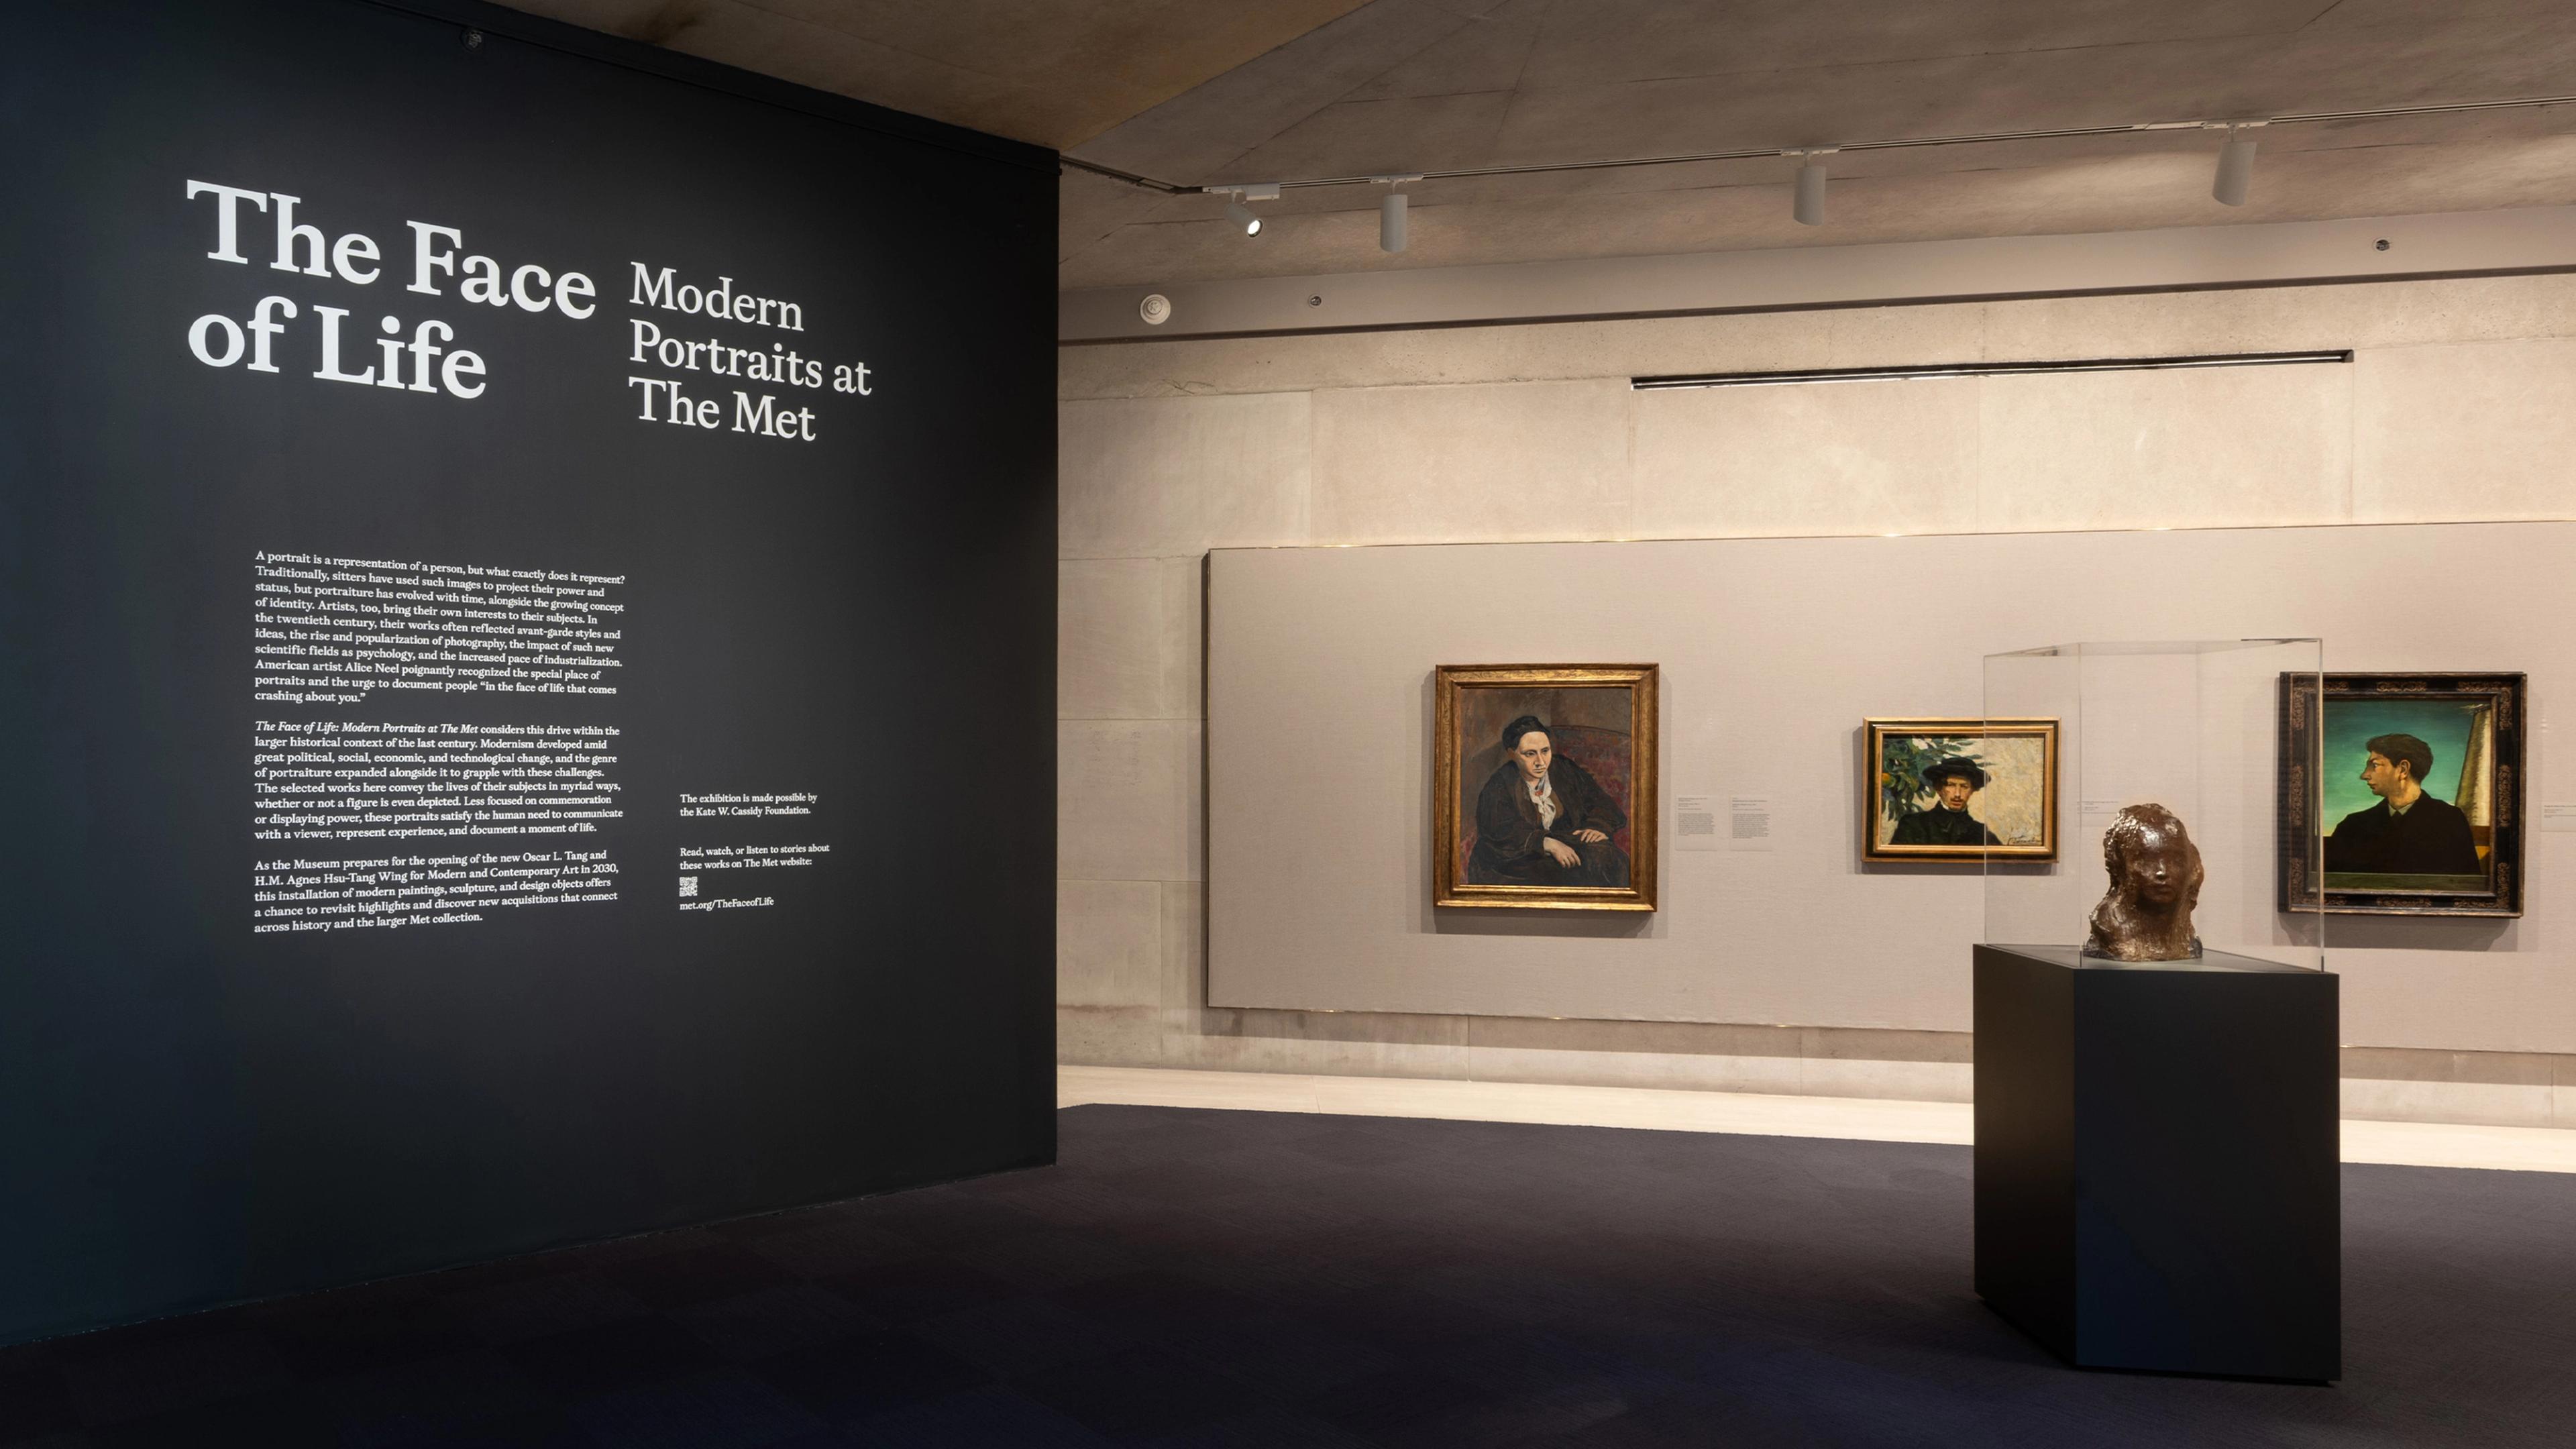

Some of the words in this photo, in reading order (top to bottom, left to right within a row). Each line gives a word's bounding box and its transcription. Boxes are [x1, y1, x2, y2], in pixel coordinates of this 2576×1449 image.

[187, 180, 380, 284] The
[407, 221, 595, 319] Face
[630, 262, 804, 331] Modern
[189, 296, 297, 373] of
[313, 305, 486, 398] Life
[630, 319, 822, 388] Portraits
[834, 362, 871, 395] at
[629, 376, 719, 429] The
[732, 391, 816, 441] Met
[256, 551, 265, 560] A
[268, 553, 311, 564] portrait
[313, 554, 322, 564] is
[333, 558, 407, 570] representation
[410, 561, 421, 570] of
[430, 565, 466, 575] person,
[468, 565, 484, 575] but
[486, 567, 510, 577] what
[512, 570, 546, 582] exactly
[548, 570, 569, 581] does
[571, 572, 578, 581] it
[580, 575, 625, 585] represent?
[255, 583, 291, 594] status,
[294, 583, 312, 594] but
[314, 587, 374, 598] portraiture
[376, 588, 394, 598] has
[396, 590, 434, 601] evolved
[435, 592, 460, 602] with
[461, 594, 486, 605] time,
[488, 595, 532, 608] alongside
[533, 598, 549, 608] the
[550, 600, 588, 612] growing
[590, 604, 624, 614] concept
[255, 612, 274, 623] the
[277, 614, 331, 625] twentieth
[333, 619, 377, 631] century,
[380, 619, 405, 629] their
[408, 621, 439, 631] works
[441, 621, 468, 632] often
[471, 623, 515, 634] reflected
[517, 627, 574, 639] avant-garde
[575, 629, 602, 640] styles
[603, 630, 621, 639] and
[255, 676, 305, 687] portraits
[308, 676, 329, 686] and
[331, 676, 350, 687] the
[352, 680, 376, 690] urge
[378, 680, 390, 688] to
[392, 678, 443, 690] document
[445, 680, 478, 693] people
[498, 682, 514, 691] the
[516, 682, 536, 692] face
[537, 683, 549, 692] of
[549, 683, 565, 692] life
[567, 684, 586, 693] that
[256, 720, 276, 731] The
[278, 721, 302, 731] Face
[303, 721, 316, 735] of
[316, 722, 339, 735] Life:
[341, 722, 380, 732] Modern
[382, 722, 426, 733] Portraits
[427, 725, 438, 733] at
[440, 723, 459, 733] The
[460, 724, 478, 733] Met
[480, 724, 525, 734] considers
[527, 724, 545, 735] this
[547, 725, 571, 735] drive
[573, 726, 603, 735] within
[605, 726, 620, 735] the
[254, 753, 284, 765] great
[287, 752, 335, 765] political,
[338, 752, 371, 763] social,
[374, 753, 426, 764] economic,
[429, 753, 447, 762] and
[450, 753, 515, 765] technological
[517, 753, 553, 765] change,
[555, 753, 573, 763] and
[575, 753, 590, 763] the
[592, 755, 617, 765] genre
[680, 794, 698, 803] The
[699, 794, 741, 803] exhibition
[743, 794, 750, 802] is
[751, 793, 773, 802] made
[775, 793, 806, 804] possible
[808, 792, 818, 804] by
[680, 807, 694, 816] the
[696, 807, 716, 816] Kate
[718, 807, 730, 816] W.
[731, 806, 763, 818] Cassidy
[765, 806, 811, 815] Foundation.
[254, 829, 282, 839] with
[294, 829, 333, 839] viewer,
[336, 828, 386, 841] represent
[388, 826, 447, 839] experience,
[449, 825, 468, 835] and
[470, 825, 518, 835] document
[528, 824, 567, 833] moment
[568, 822, 579, 833] of
[580, 822, 597, 832] life.
[680, 847, 704, 857] Read,
[706, 846, 734, 856] watch,
[746, 845, 768, 854] listen
[780, 845, 806, 853] stories
[808, 843, 830, 852] about
[254, 861, 270, 871] As
[272, 859, 290, 870] the
[293, 859, 340, 869] Museum
[343, 859, 389, 871] prepares
[391, 856, 407, 866] for
[409, 855, 425, 865] the
[428, 855, 468, 867] opening
[470, 853, 481, 863] of
[482, 853, 498, 863] the
[523, 852, 551, 862] Oscar
[553, 851, 562, 861] L.
[564, 851, 588, 863] Tang
[590, 850, 606, 859] and
[680, 861, 702, 870] these
[704, 859, 730, 869] works
[743, 859, 761, 867] The
[762, 858, 778, 867] Met
[780, 857, 812, 866] website:
[255, 875, 284, 886] H.M.
[286, 875, 321, 888] Agnes
[324, 873, 376, 885] Hsu-Tang
[378, 871, 408, 883] Wing
[410, 870, 425, 880] for
[427, 869, 466, 879] Modern
[469, 868, 488, 878] and
[490, 867, 560, 879] Contemporary
[561, 865, 579, 874] Art
[581, 865, 590, 873] in
[592, 863, 619, 873] 2030,
[680, 897, 774, 912] met.org/TheFaceofLife
[254, 924, 290, 932] across
[292, 920, 332, 932] history
[334, 918, 354, 928] and
[356, 917, 374, 927] the
[376, 916, 407, 928] larger
[410, 914, 430, 924] Met
[432, 912, 483, 923] collection.
